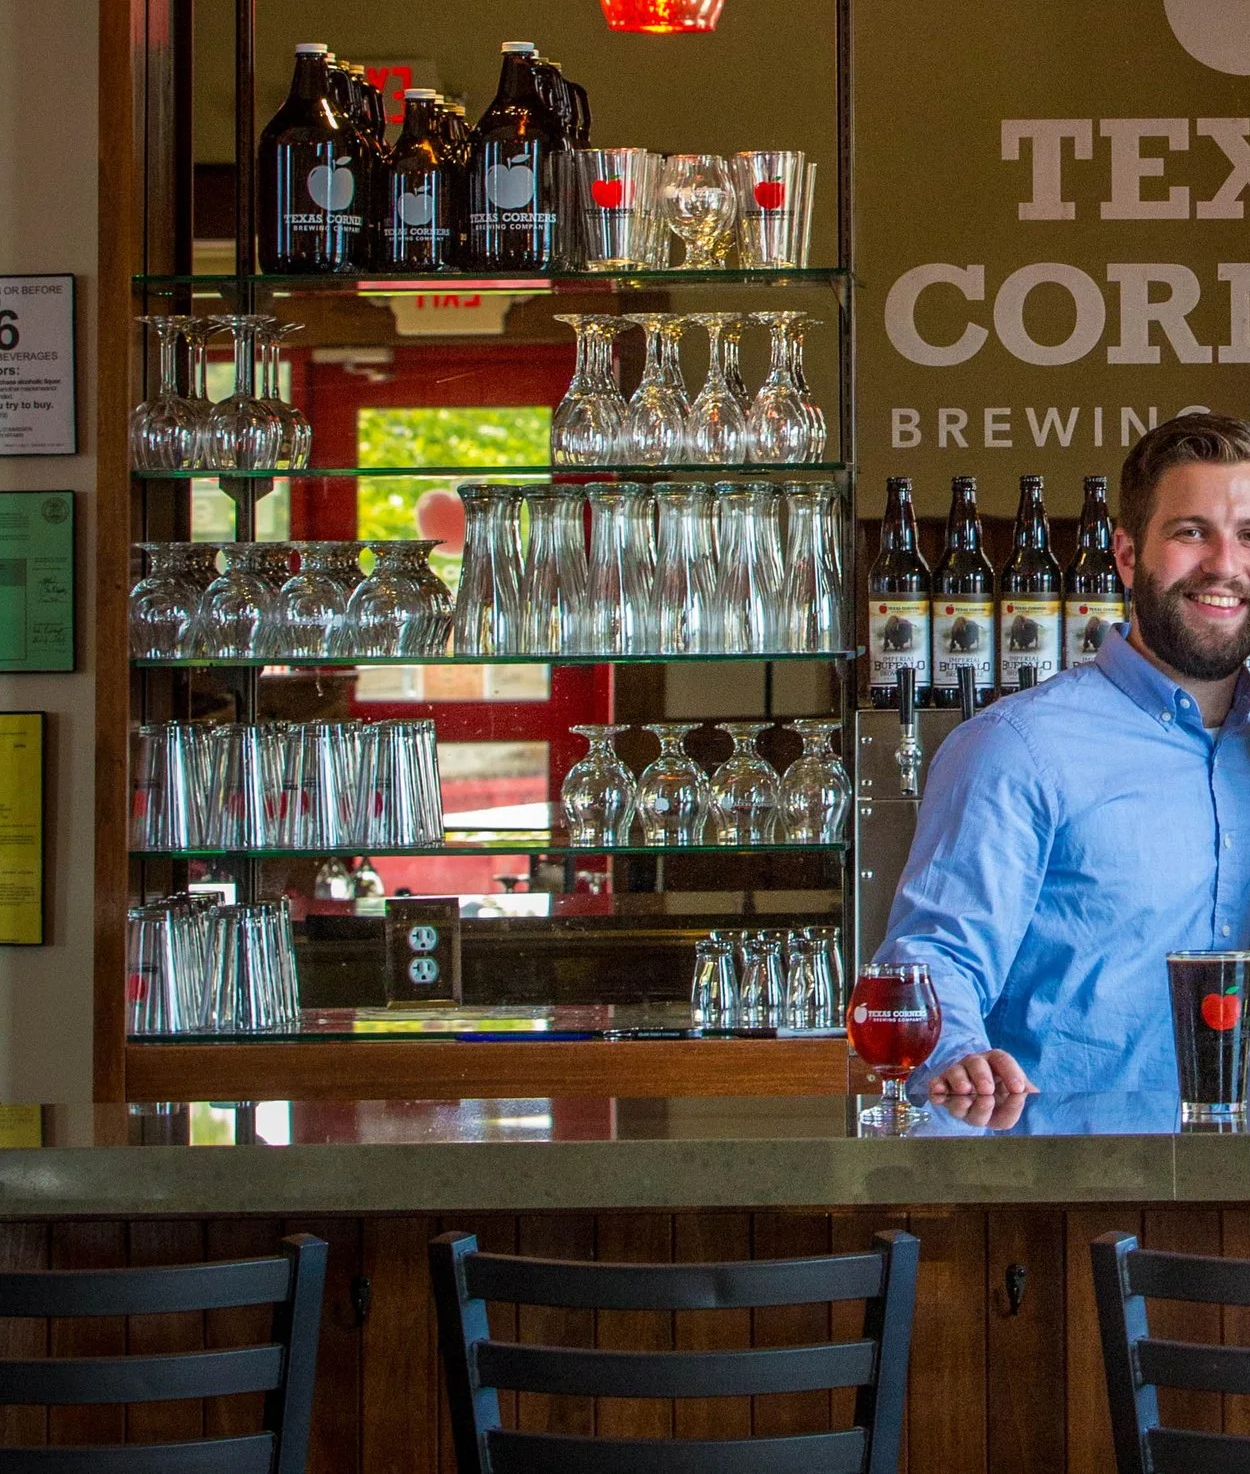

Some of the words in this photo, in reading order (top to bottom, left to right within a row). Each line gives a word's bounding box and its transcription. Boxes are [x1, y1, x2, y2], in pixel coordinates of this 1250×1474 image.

[284, 214, 323, 224] TEXAS
[470, 213, 498, 223] TEXAS
[502, 212, 556, 223] CORNERS
[4, 286, 20, 295] OR
[22, 285, 63, 295] BEFORE
[6, 401, 19, 411] try
[21, 401, 31, 409] to
[34, 401, 54, 411] buy.
[891, 405, 1212, 449] BREWIN
